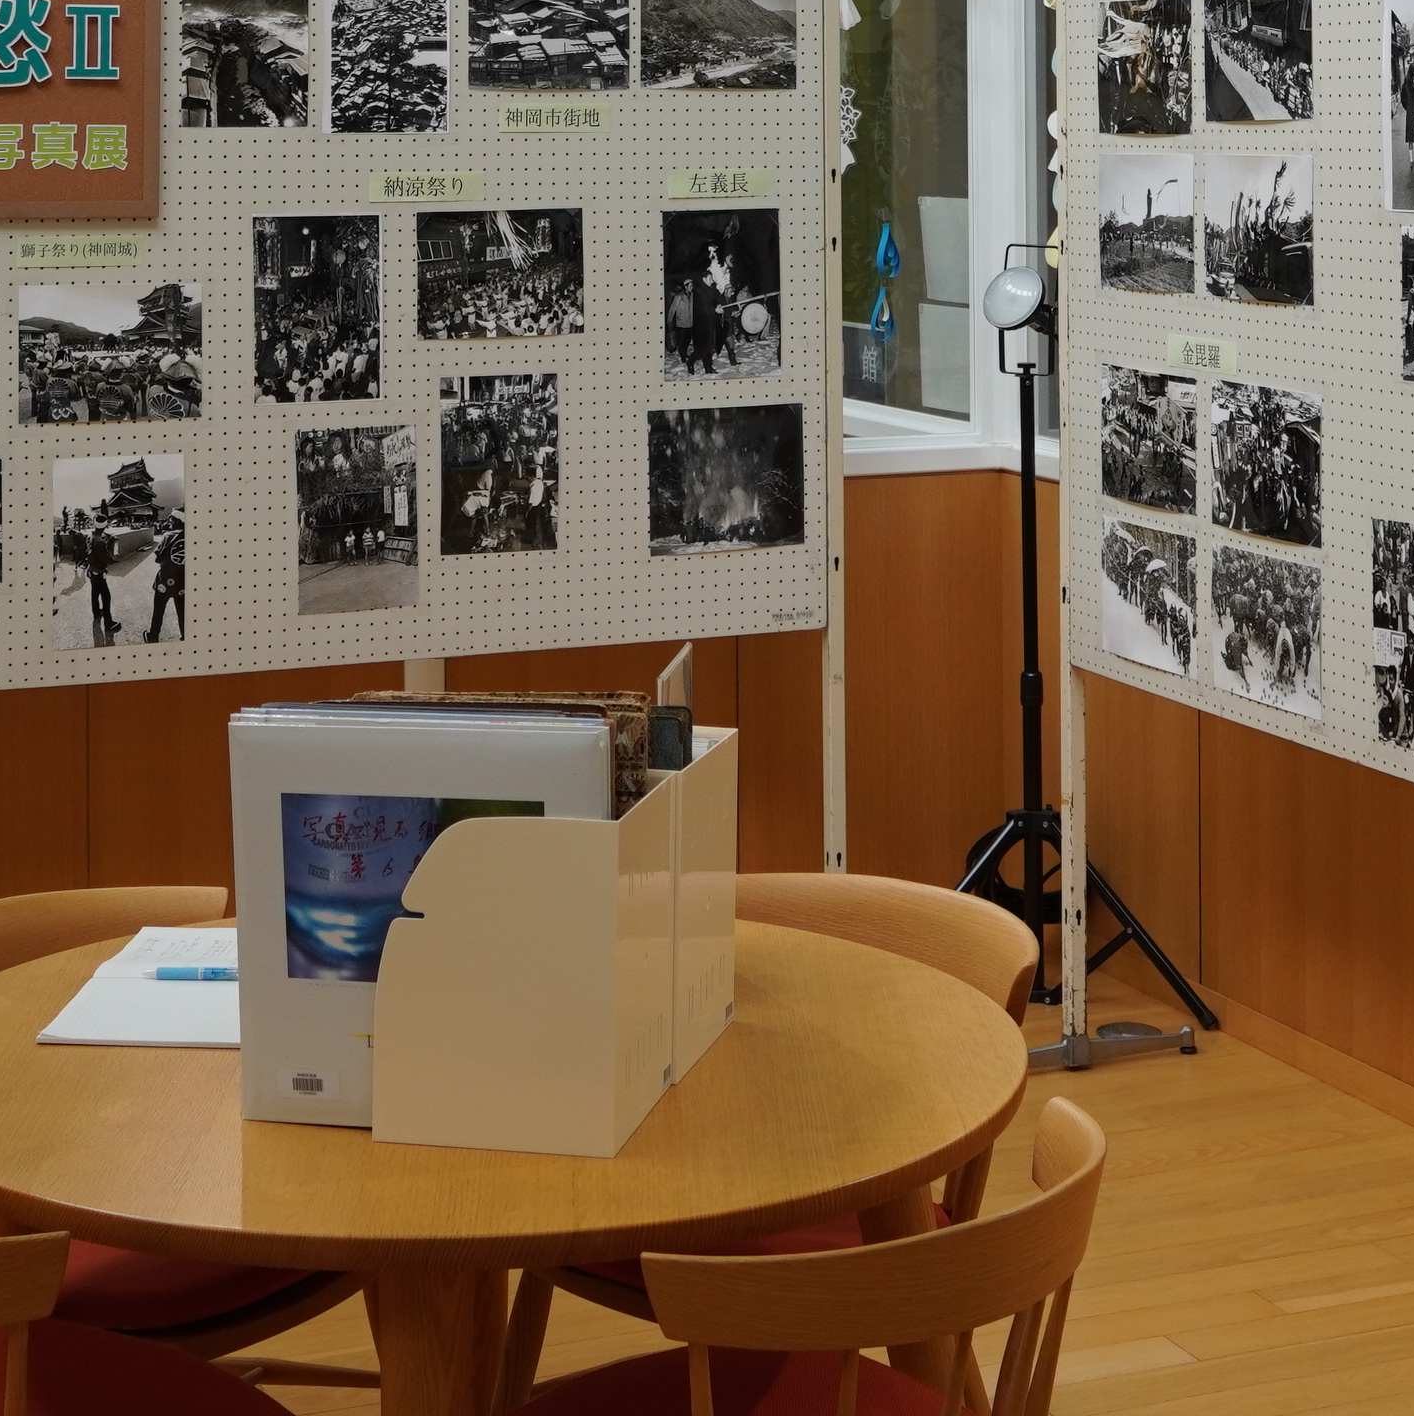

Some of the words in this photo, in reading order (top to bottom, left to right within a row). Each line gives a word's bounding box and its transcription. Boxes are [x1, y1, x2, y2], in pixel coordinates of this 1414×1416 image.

[504, 107, 601, 128] 神岡市街地
[383, 175, 465, 198] 納涼祭り
[688, 172, 750, 194] 左義長
[20, 242, 138, 260] 獅子祭り(神岡城)
[1181, 340, 1221, 369] 金毘羅
